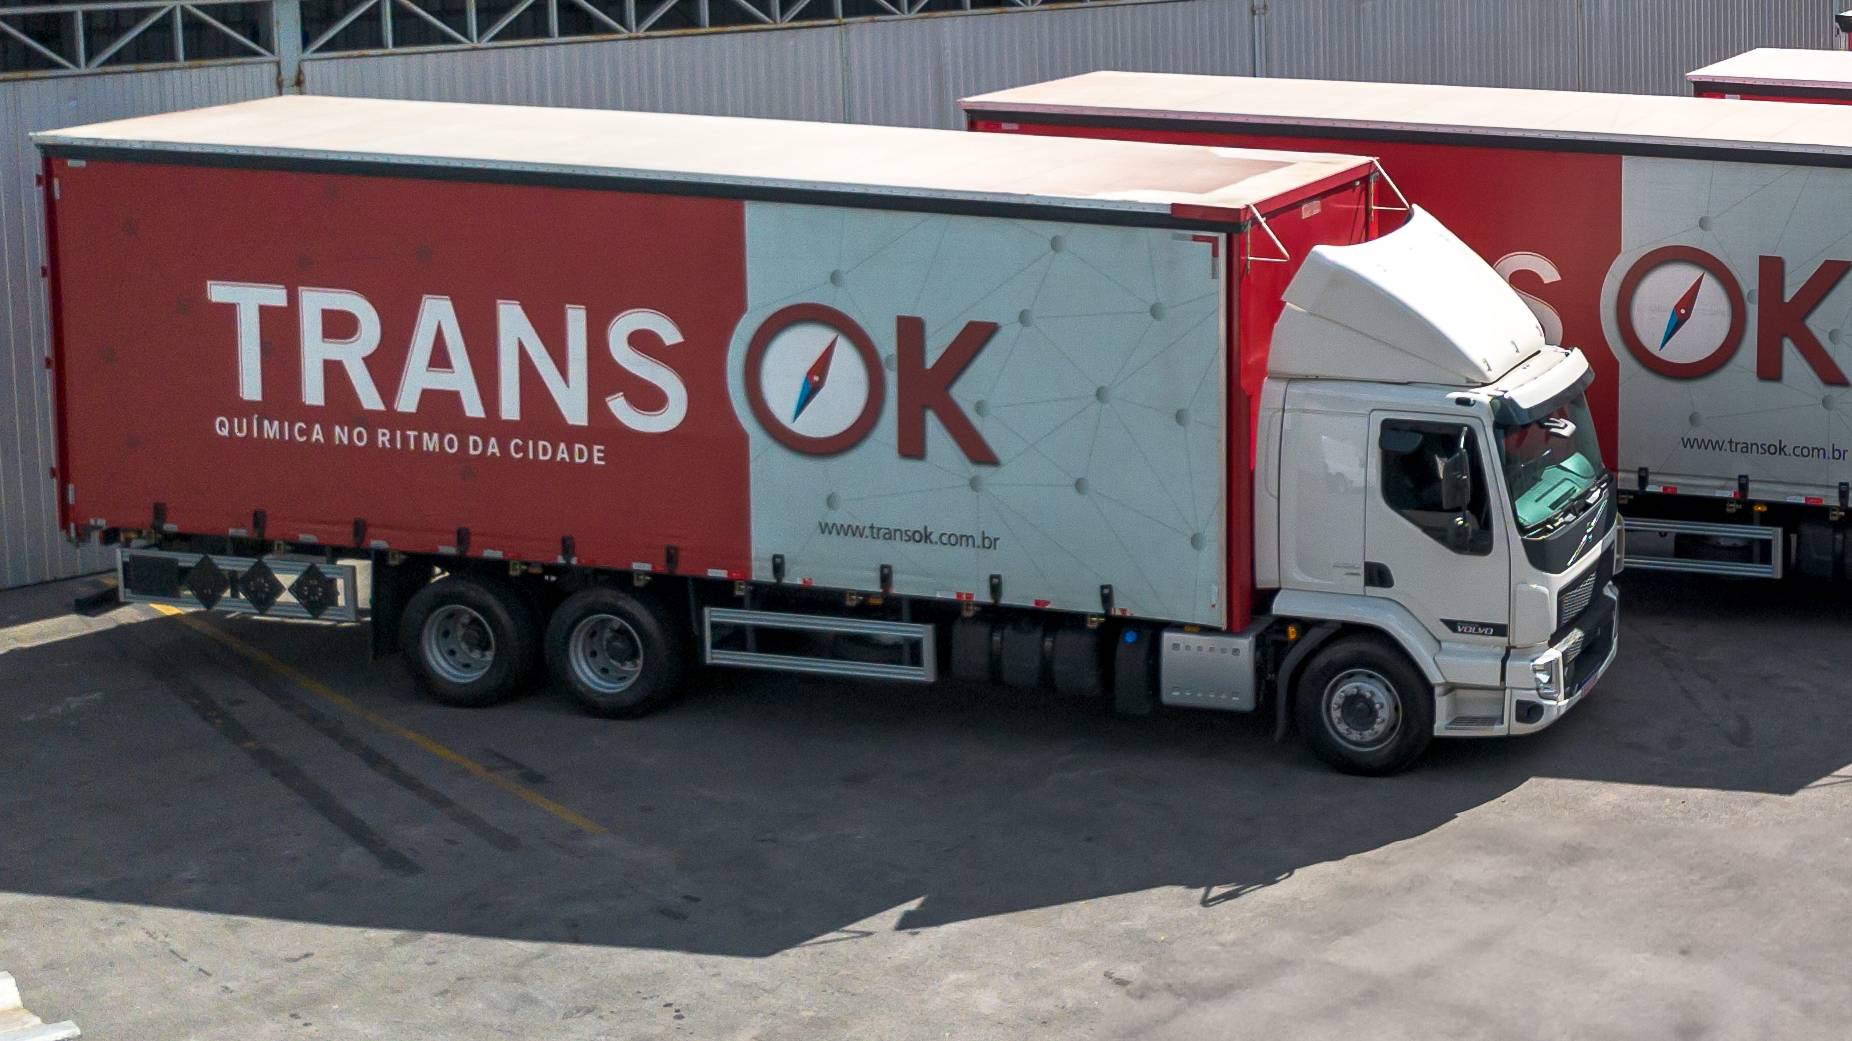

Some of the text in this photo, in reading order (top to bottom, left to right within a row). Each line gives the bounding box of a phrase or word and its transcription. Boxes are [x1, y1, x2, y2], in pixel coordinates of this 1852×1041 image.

[207, 281, 687, 433] TRANS
[214, 413, 606, 465] QUÍMICA NO RITMO DA CIDADE
[1681, 436, 1848, 460] www.transok.com.br
[818, 520, 1000, 550] www.transok.com.br
[1457, 624, 1493, 635] VOLVO
